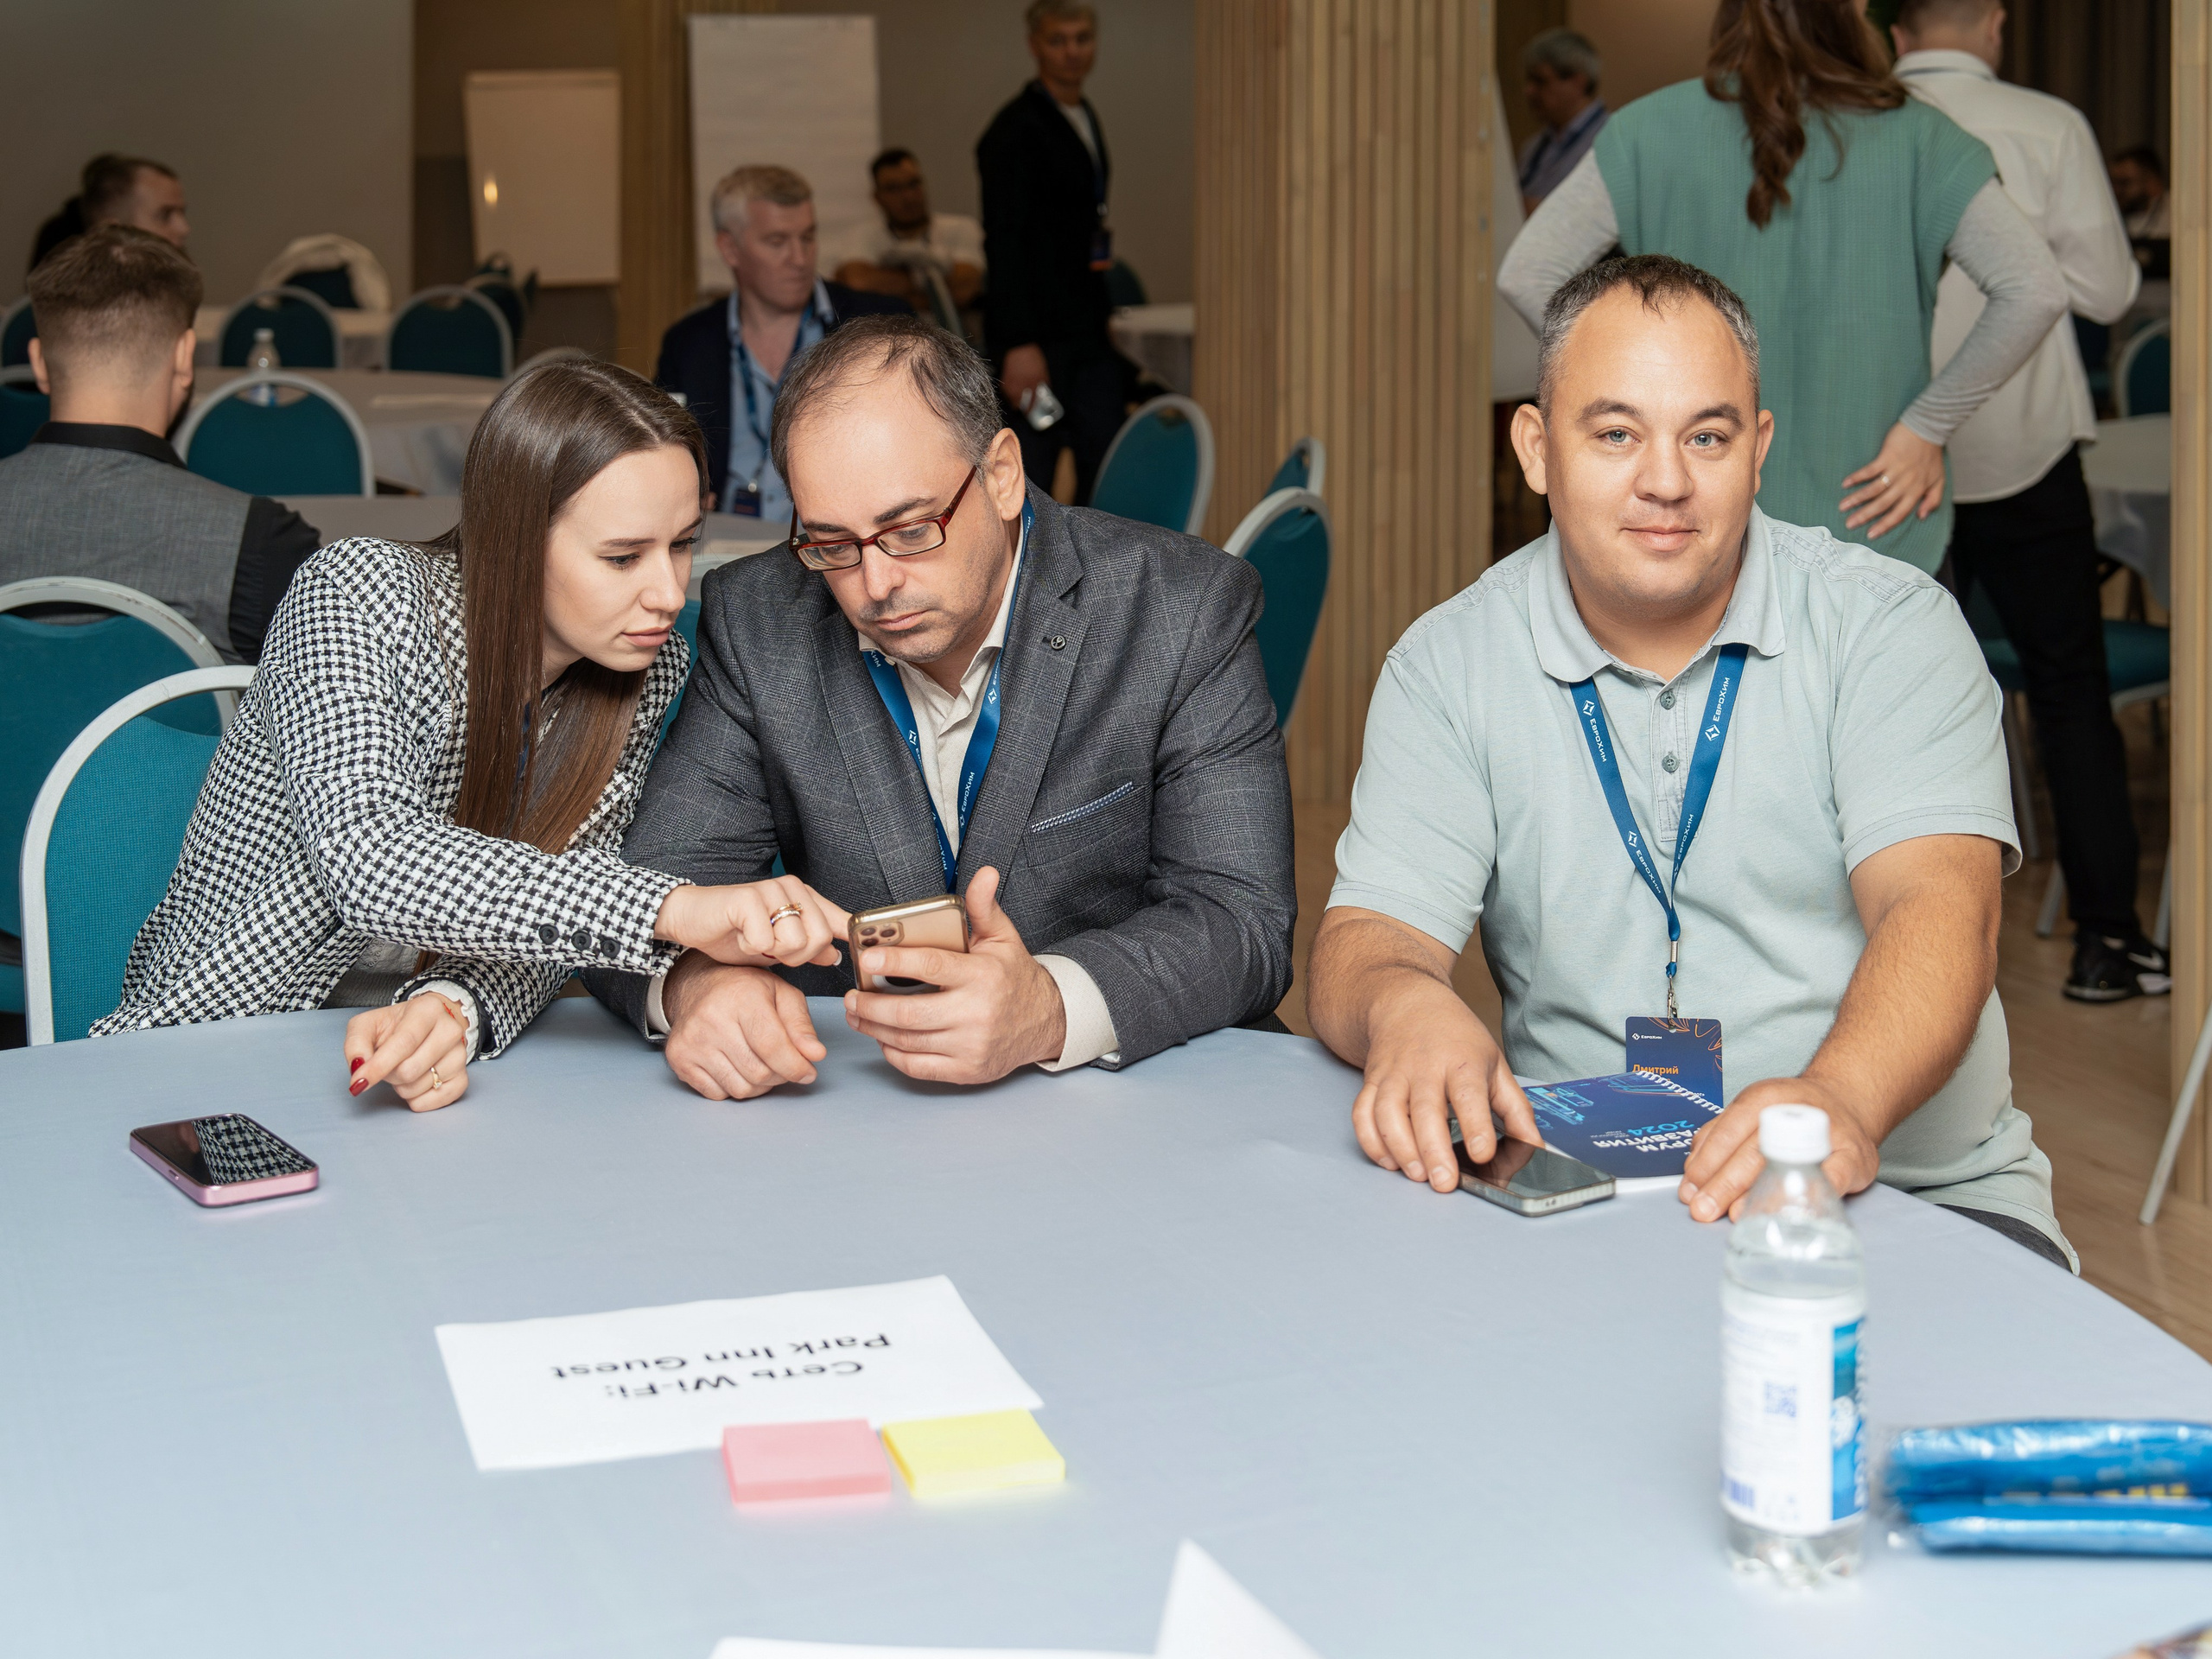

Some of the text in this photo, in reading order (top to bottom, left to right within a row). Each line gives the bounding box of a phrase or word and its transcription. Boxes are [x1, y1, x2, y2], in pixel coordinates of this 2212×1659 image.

[1632, 1064, 1679, 1076] Дмитрий
[1627, 1120, 1694, 1135] 2024
[1636, 1138, 1693, 1153] ОРУМ
[550, 1332, 892, 1379] Park Inn Guest
[605, 1360, 864, 1398] Сеть Wi-Fi:
